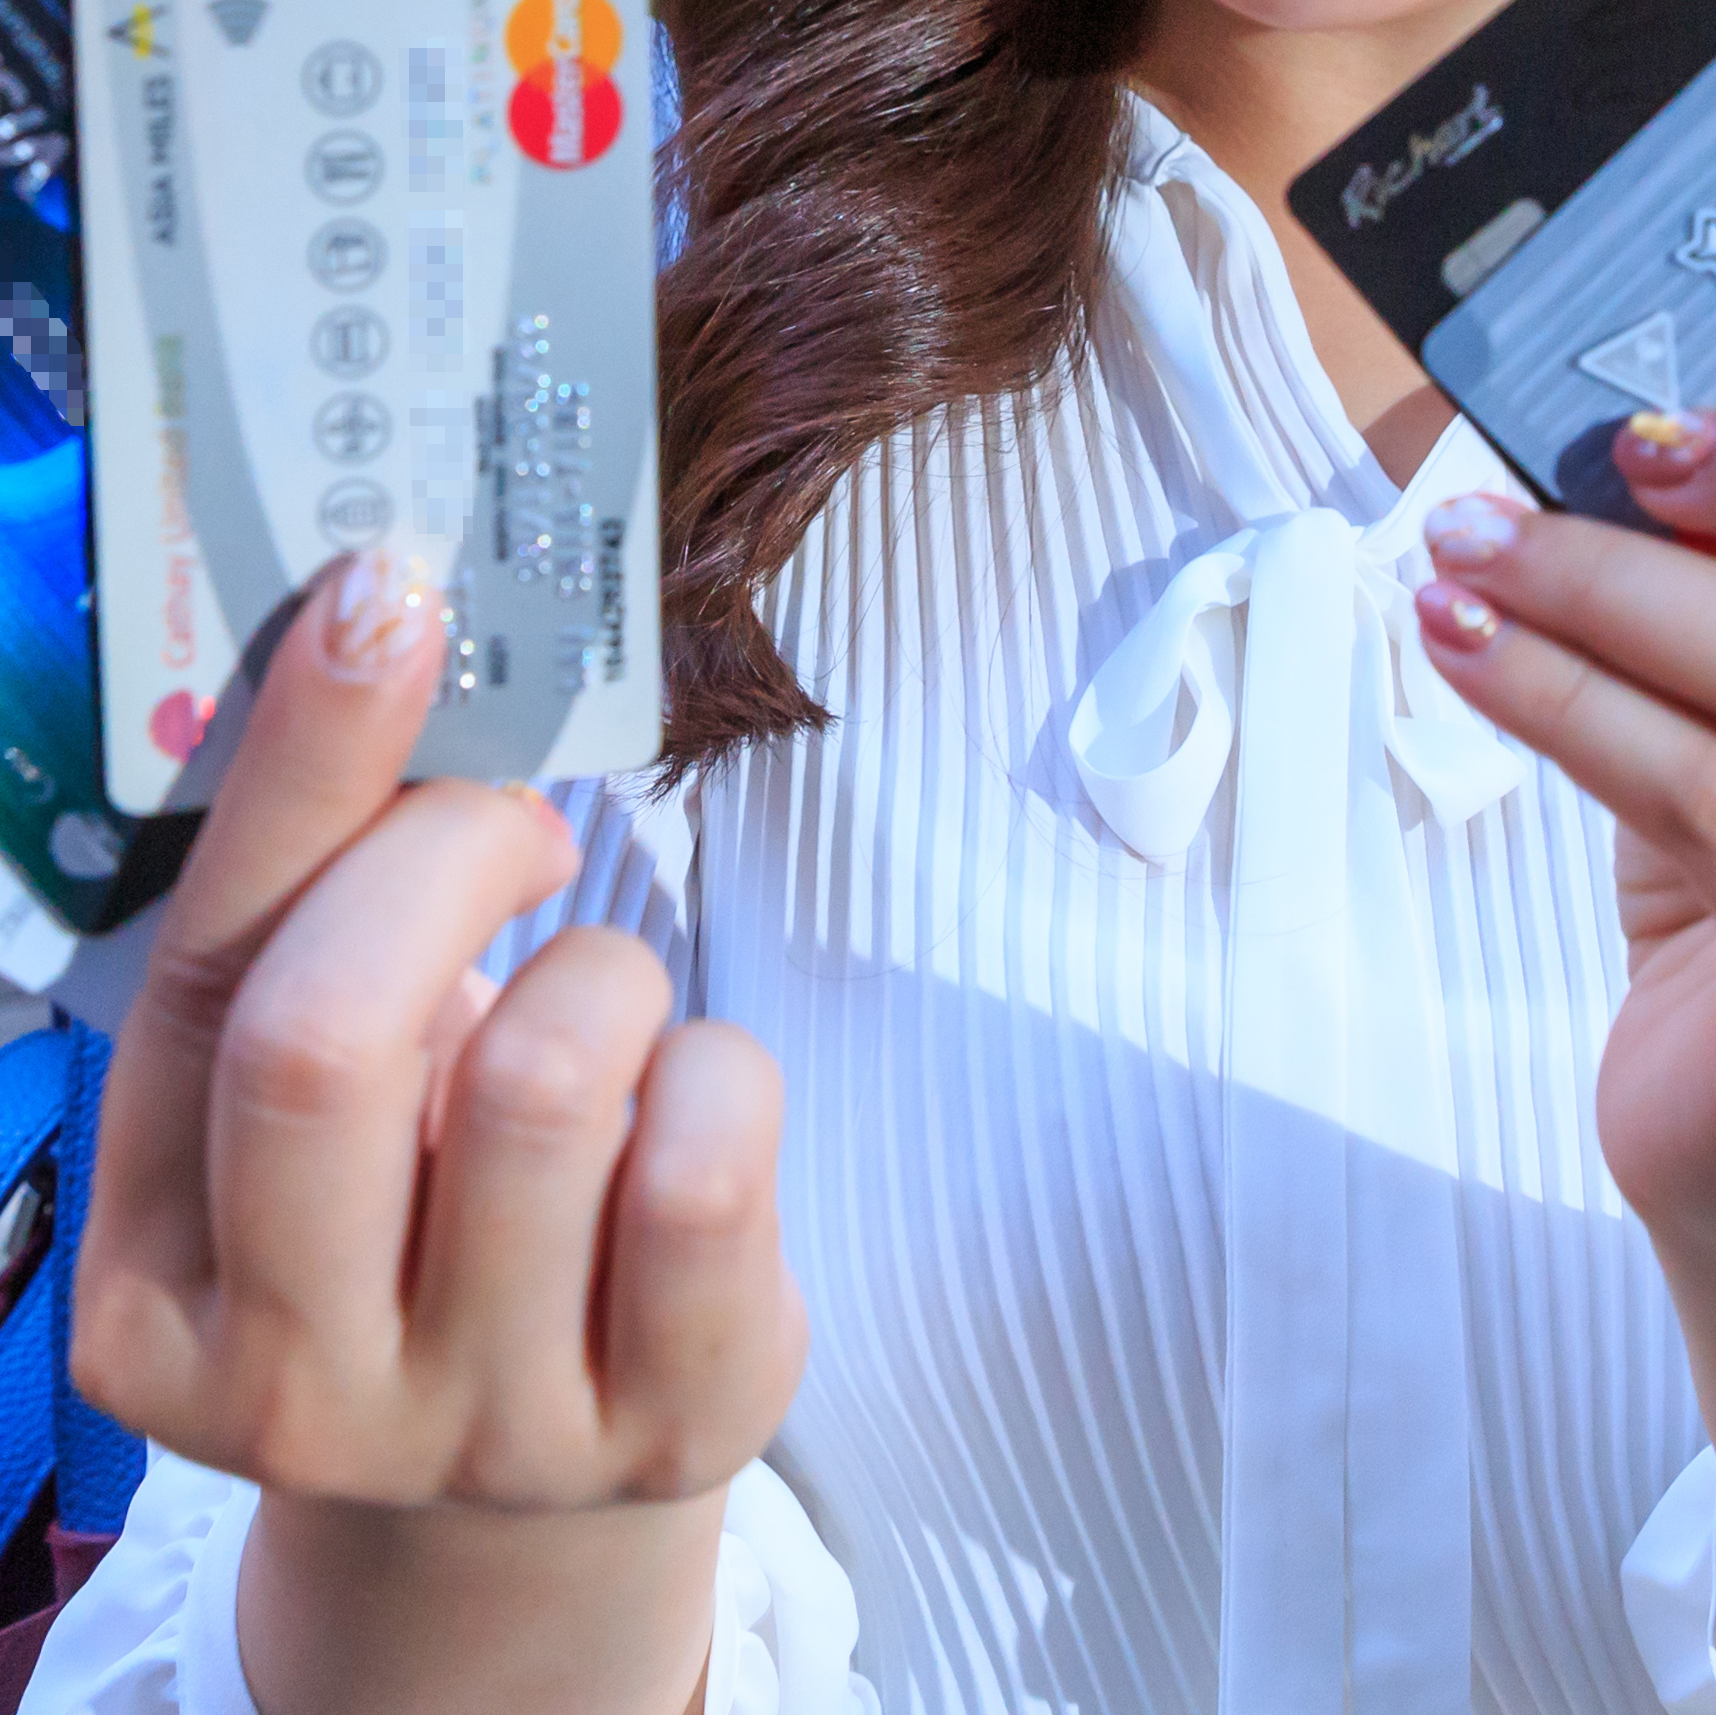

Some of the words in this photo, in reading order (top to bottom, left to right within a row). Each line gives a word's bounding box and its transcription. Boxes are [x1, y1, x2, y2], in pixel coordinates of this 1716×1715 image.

[142, 74, 174, 166] MILES
[146, 174, 177, 248] ASIA
[158, 427, 193, 546] United
[160, 552, 199, 670] Cathay
